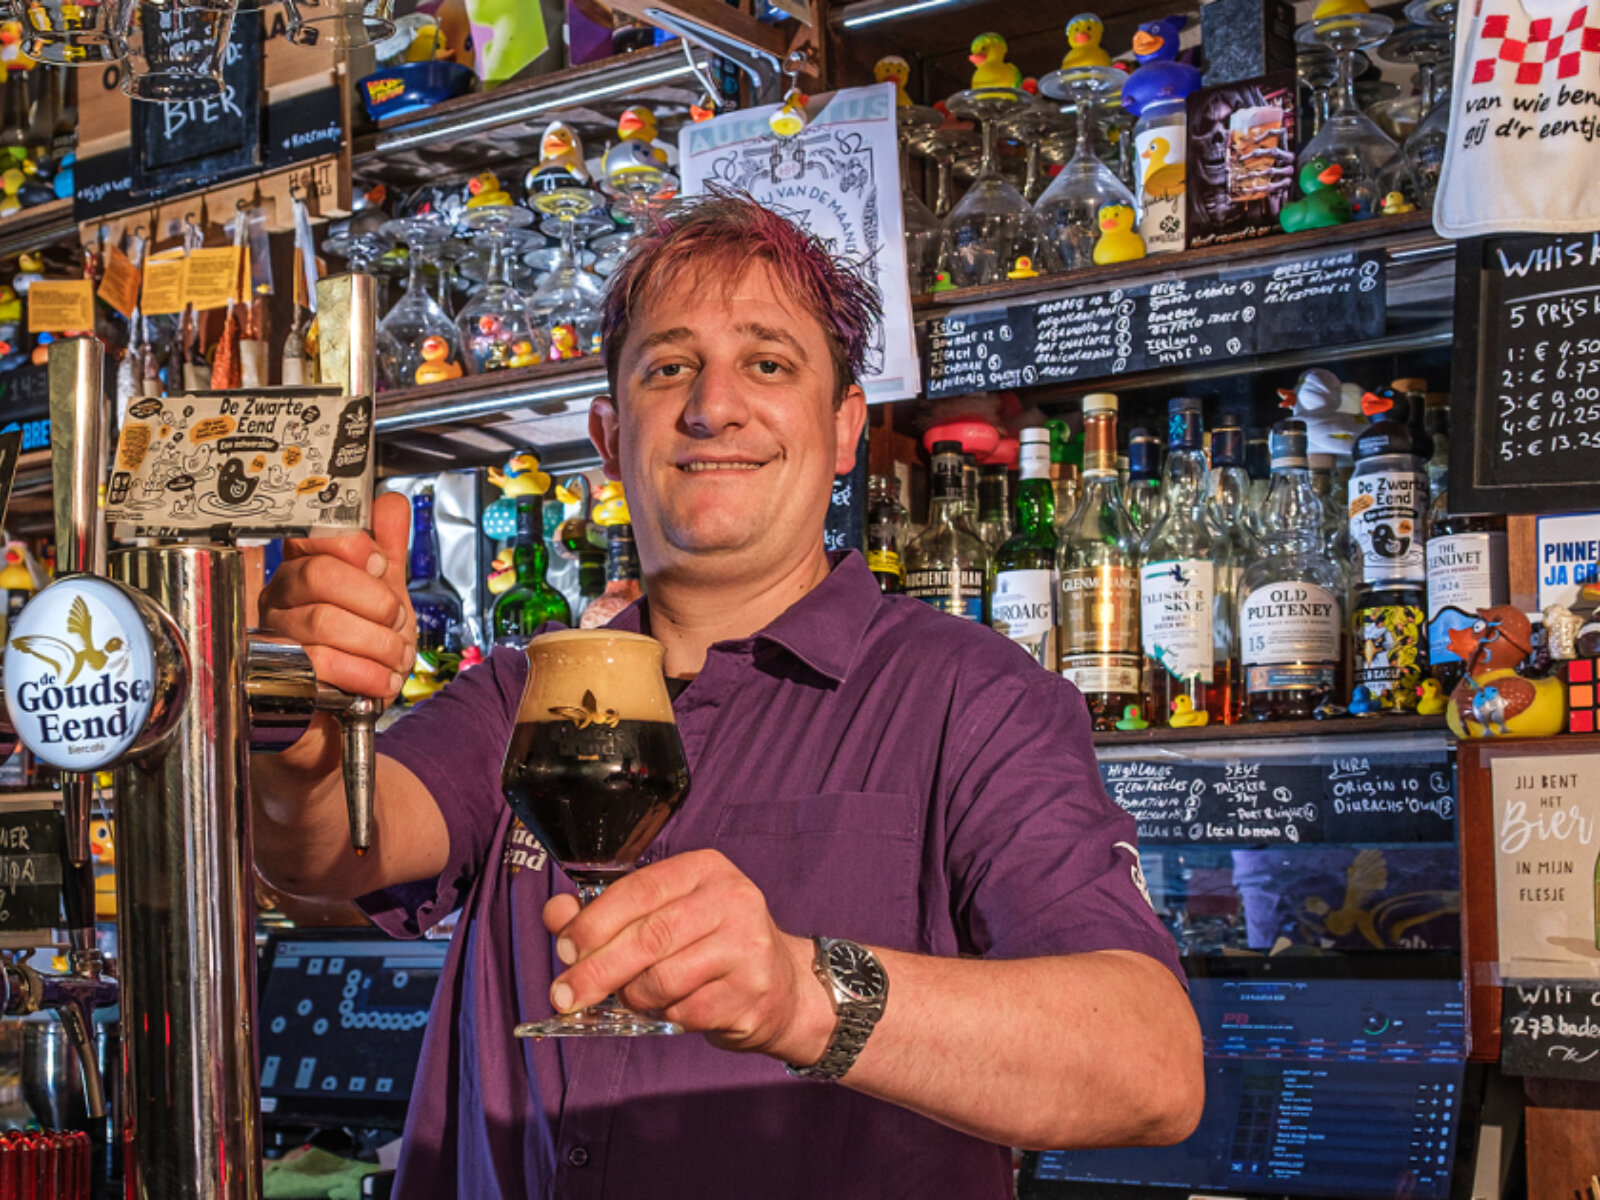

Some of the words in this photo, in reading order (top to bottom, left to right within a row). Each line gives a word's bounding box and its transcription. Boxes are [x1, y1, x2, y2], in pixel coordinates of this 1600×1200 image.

[159, 86, 243, 139] BIER
[1466, 96, 1502, 114] van
[1513, 92, 1551, 113] wie
[1463, 118, 1490, 149] gij
[1495, 118, 1534, 139] d'r
[777, 185, 806, 198] VAN
[809, 186, 830, 204] DE
[827, 199, 858, 254] MAAND
[1511, 305, 1528, 328] 5
[1508, 348, 1526, 362] 1:
[1535, 341, 1549, 362] €
[1502, 370, 1523, 388] 2:
[1530, 369, 1545, 383] €
[1556, 359, 1600, 383] 6.75
[220, 398, 238, 414] De
[243, 397, 303, 414] Zwarte
[1499, 395, 1523, 418] 3:
[1527, 392, 1543, 410] €
[237, 417, 277, 433] Eend
[1502, 419, 1523, 436] 4:
[1526, 415, 1541, 431] €
[1549, 404, 1600, 428] 11.25
[1500, 441, 1522, 461] 5:
[1527, 439, 1543, 456] €
[1551, 432, 1600, 452] 13.25
[1358, 480, 1372, 493] De
[1376, 492, 1411, 505] Eend
[1438, 543, 1455, 553] THE
[1544, 540, 1600, 564] PINNE
[1545, 565, 1568, 586] JA
[1270, 590, 1307, 602] OLD
[1248, 604, 1332, 620] PULTENEY
[1249, 636, 1265, 652] 15
[40, 673, 56, 685] de
[17, 673, 150, 712] Goudse
[37, 706, 128, 743] Eend
[1401, 778, 1419, 791] 10
[1515, 775, 1534, 789] JIJ
[1541, 774, 1578, 789] BENT
[1540, 796, 1562, 808] HET
[1501, 800, 1594, 854] Bier
[1516, 861, 1531, 874] IN
[1538, 861, 1574, 874] MIJN
[1519, 888, 1565, 901] FLESJE
